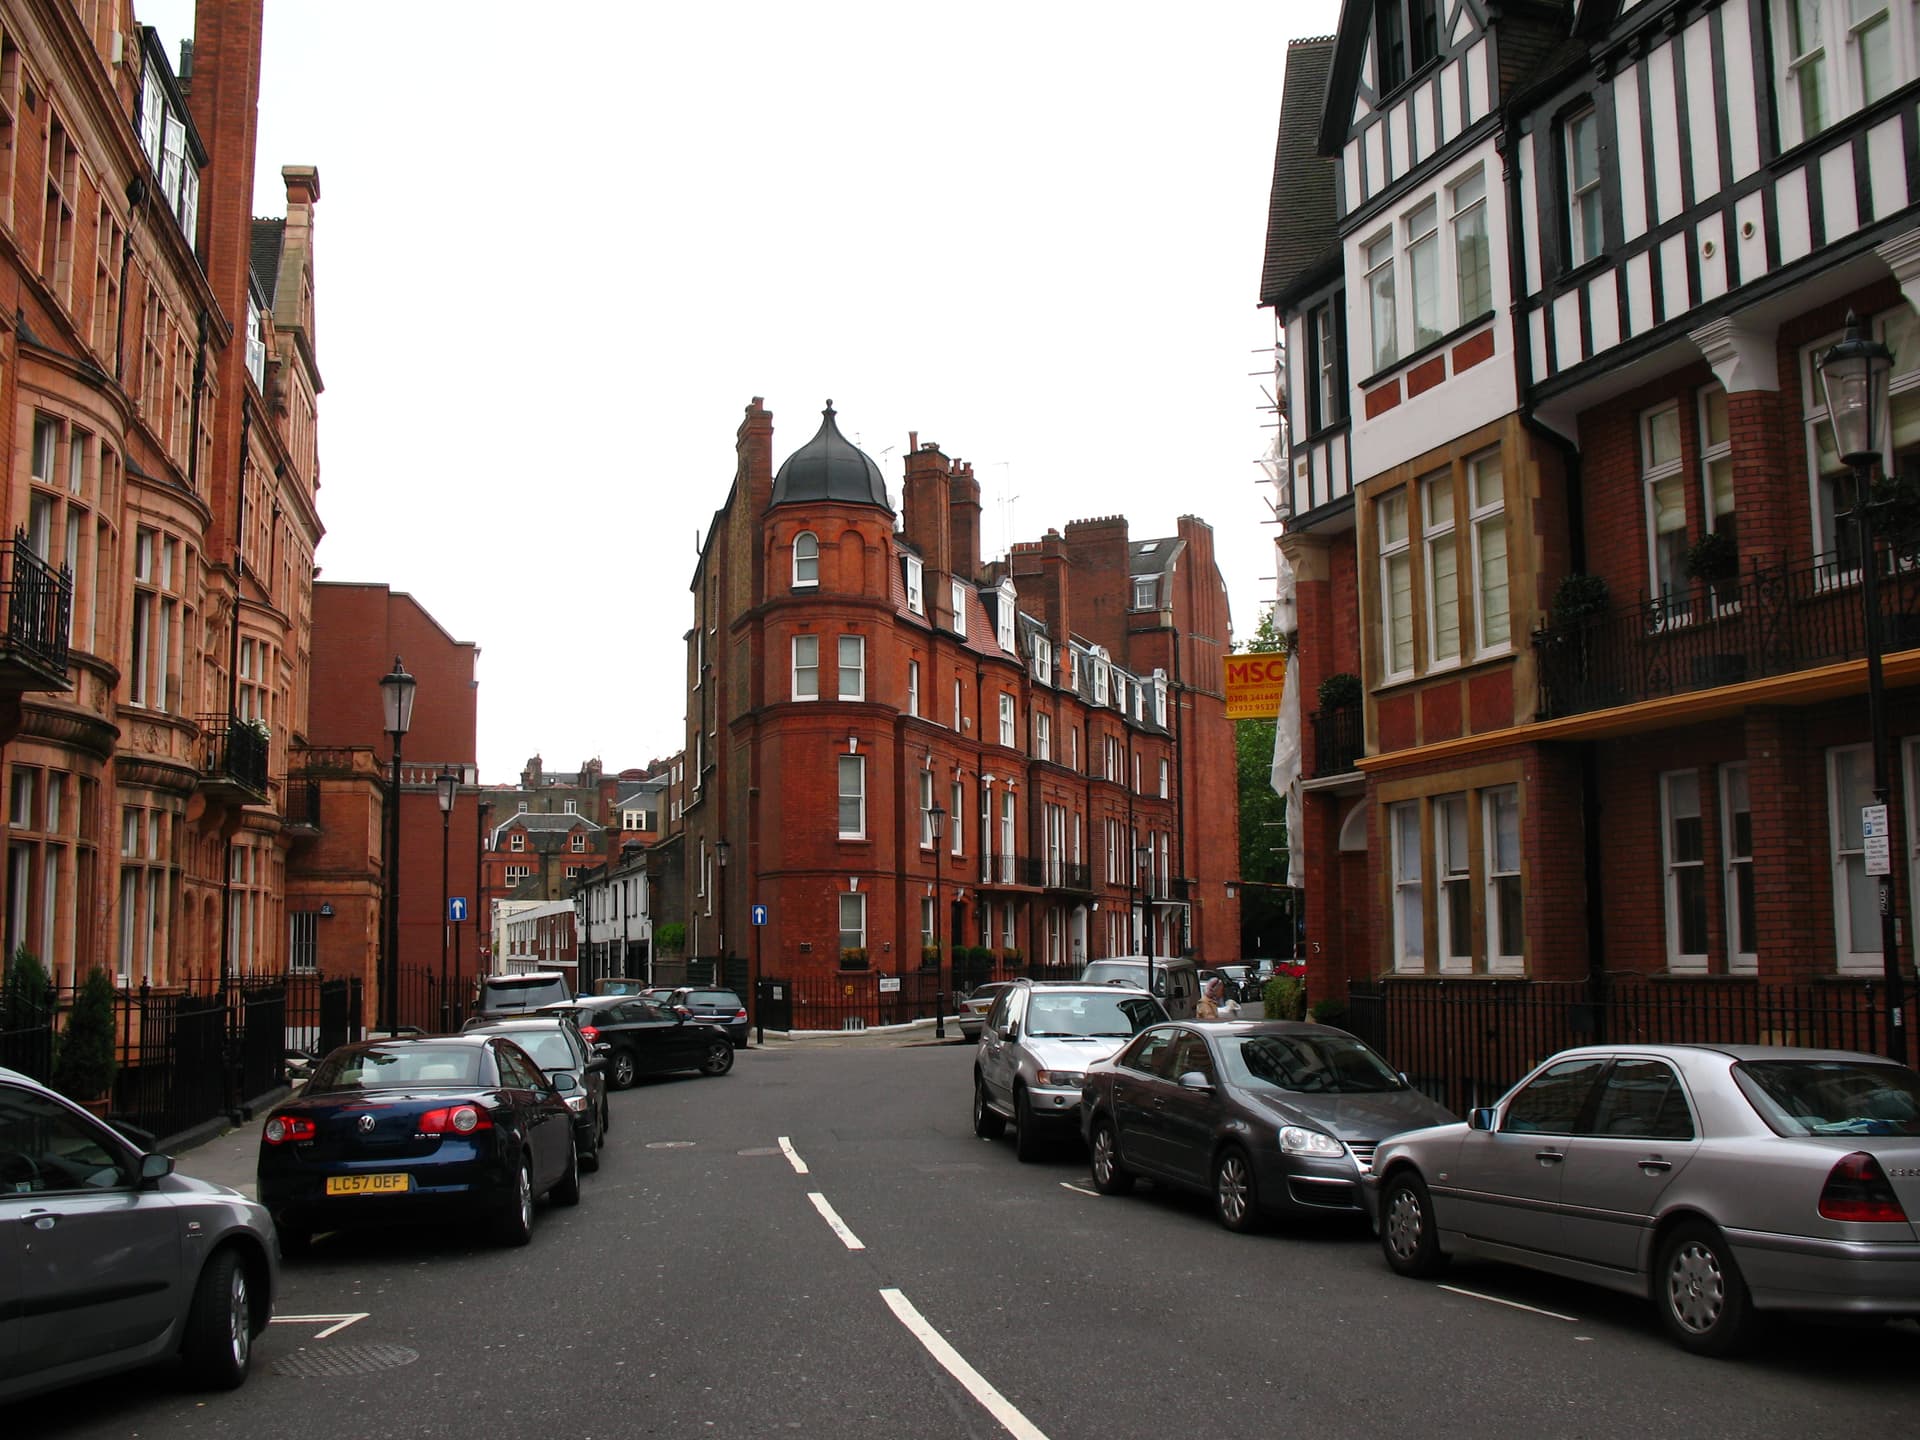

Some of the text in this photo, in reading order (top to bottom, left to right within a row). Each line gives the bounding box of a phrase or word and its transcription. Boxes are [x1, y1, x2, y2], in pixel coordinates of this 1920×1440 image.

[1228, 661, 1283, 684] MSC
[1312, 942, 1321, 954] 3
[333, 1176, 370, 1191] LC57
